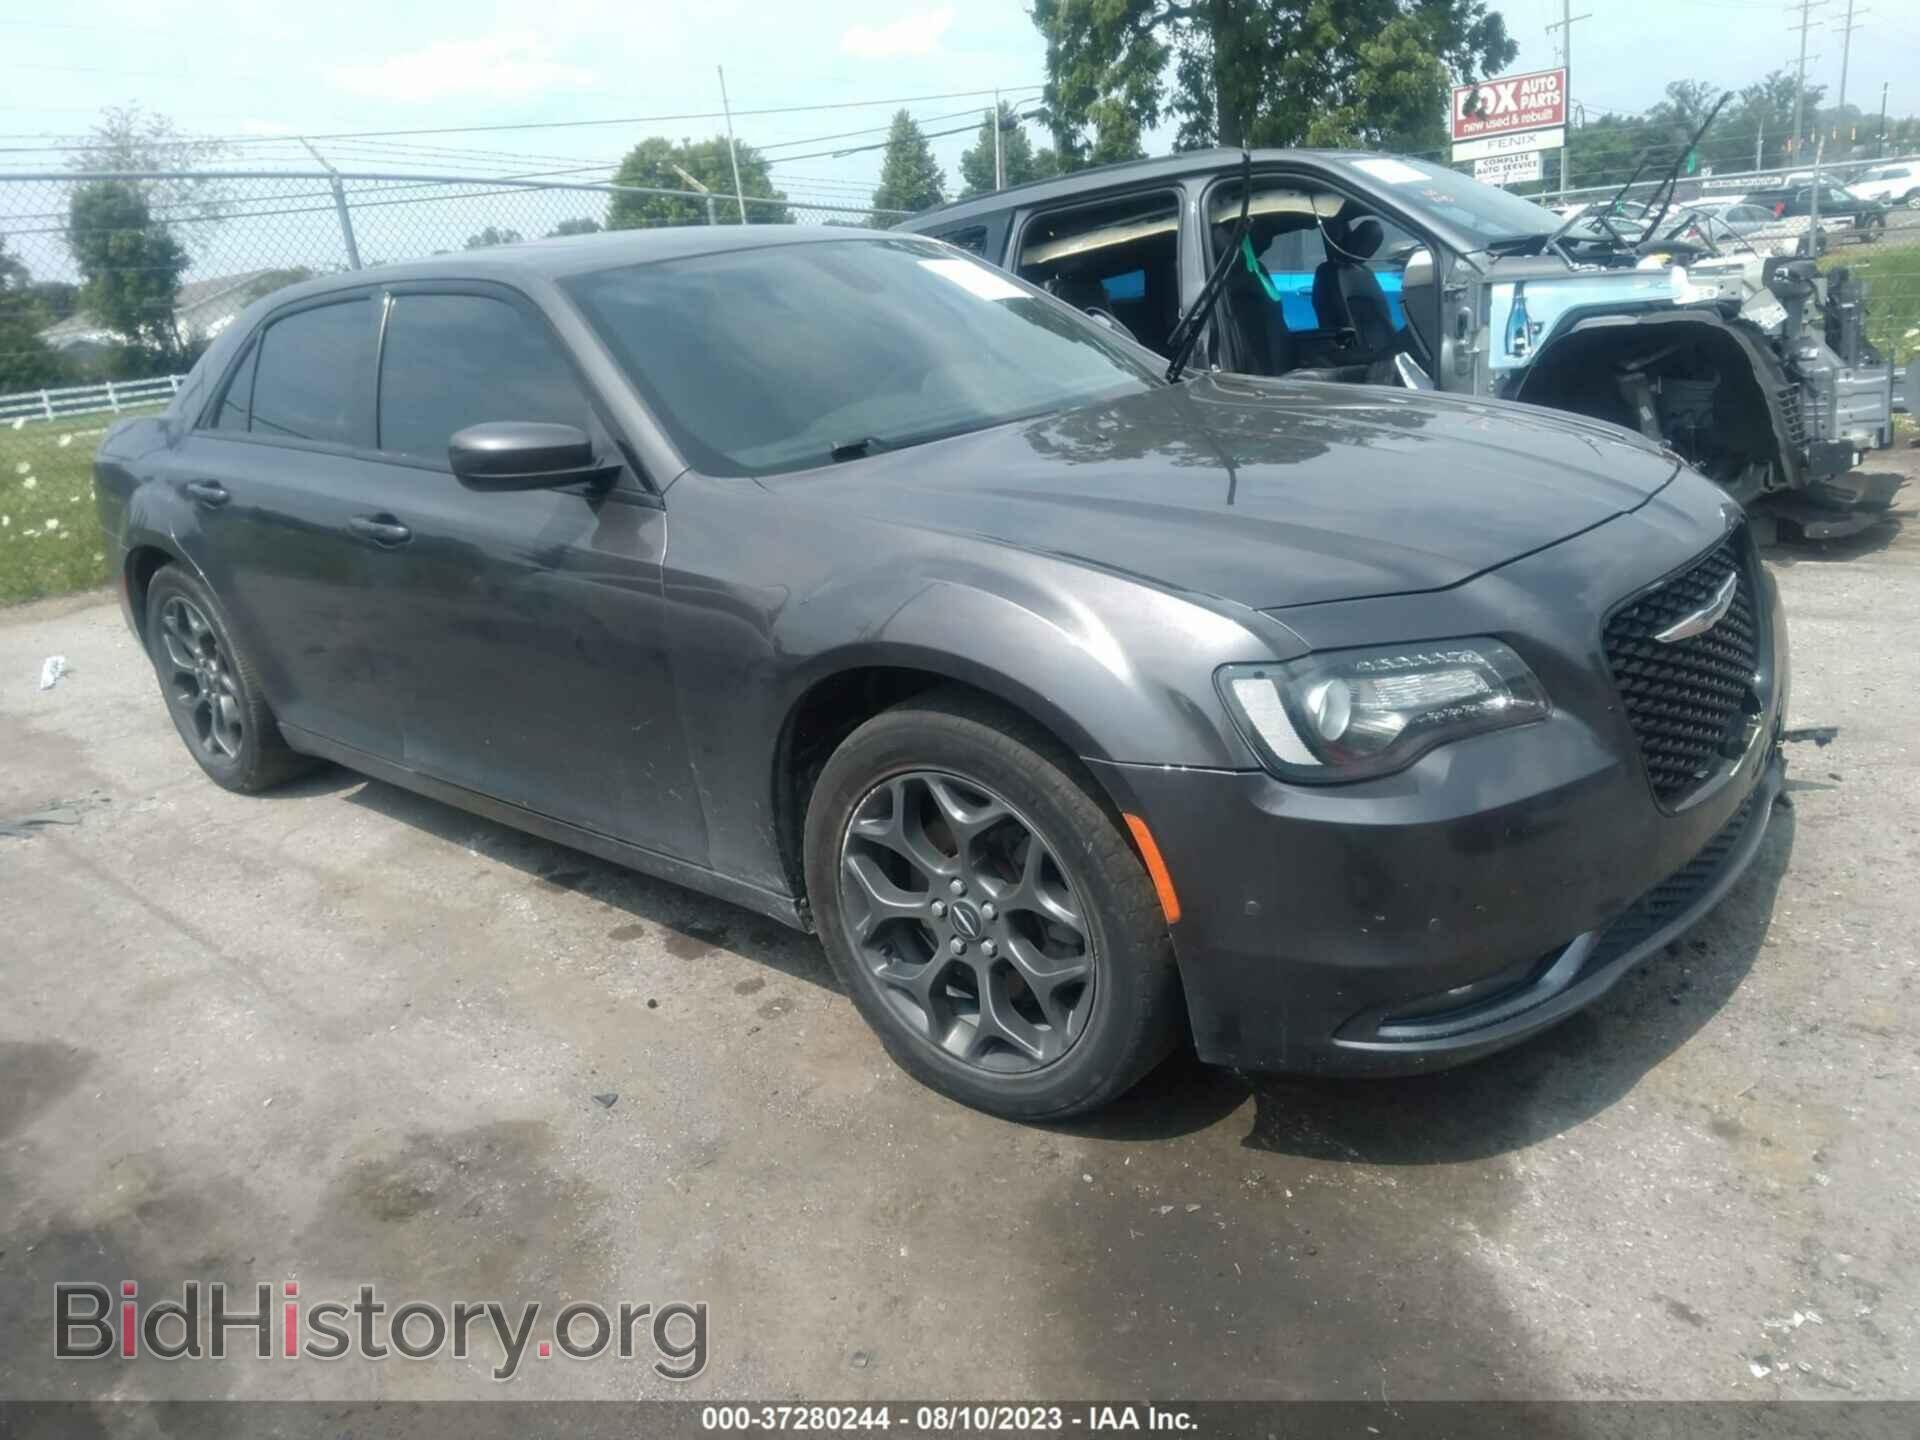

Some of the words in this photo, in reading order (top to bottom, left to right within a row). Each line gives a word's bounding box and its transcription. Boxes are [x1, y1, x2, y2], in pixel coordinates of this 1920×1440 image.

[1521, 76, 1557, 94] AUTO
[1520, 90, 1561, 110] PARTS
[1463, 121, 1485, 134] new
[1486, 114, 1510, 130] used
[1521, 109, 1553, 123] rebuilt
[1488, 134, 1536, 150] FENIX
[1476, 165, 1500, 175] AUTO
[1503, 160, 1537, 172] SERVICE
[1483, 154, 1529, 166] COMPLETE
